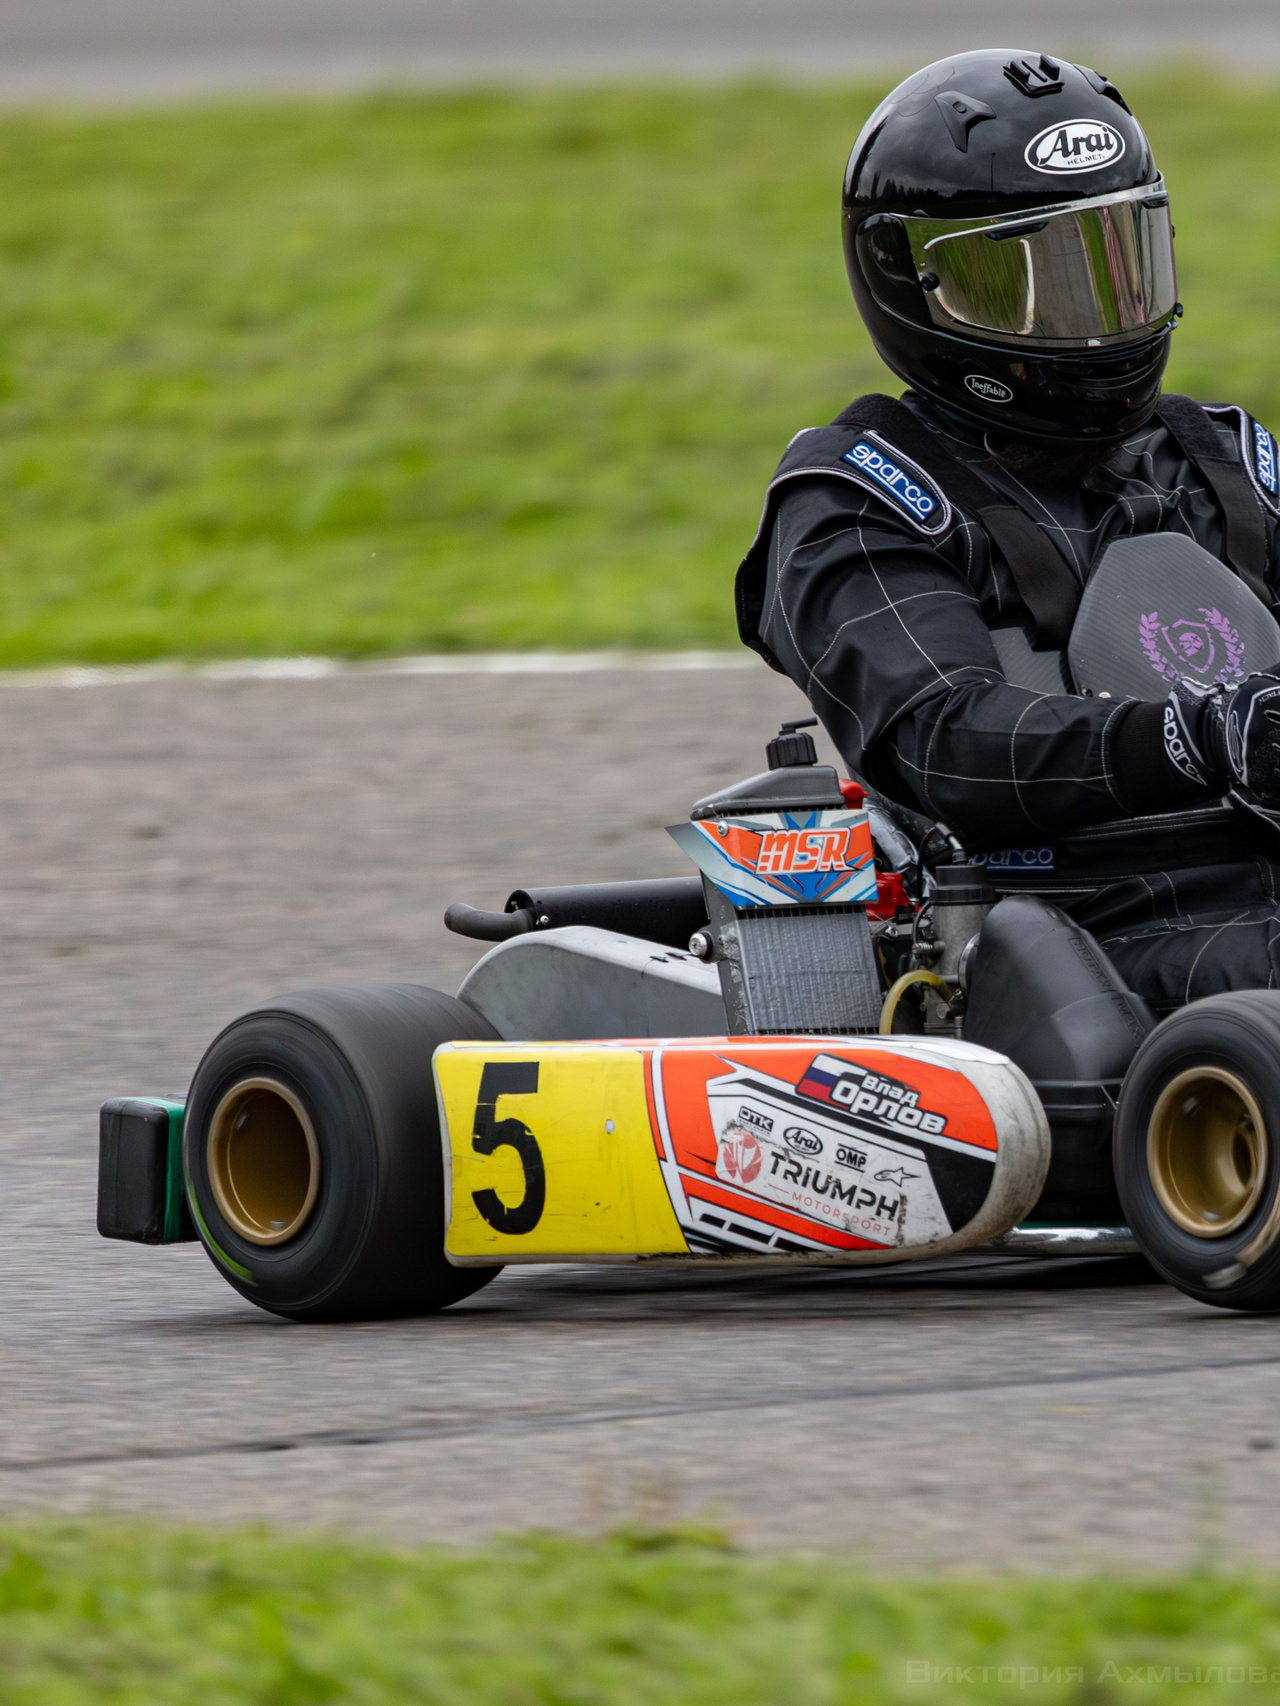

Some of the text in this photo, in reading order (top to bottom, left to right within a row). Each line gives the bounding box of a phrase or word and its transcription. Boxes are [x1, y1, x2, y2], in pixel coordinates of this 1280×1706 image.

[1037, 126, 1114, 166] Arai
[1067, 153, 1103, 166] HELMET
[971, 377, 1007, 398] Ineffable
[852, 445, 934, 512] sparco
[757, 829, 850, 873] MSR
[967, 848, 1054, 866] parco
[831, 1080, 947, 1134] Орлов
[861, 1074, 920, 1107] Влад
[739, 1106, 774, 1132] OTK
[472, 1061, 546, 1235] 5
[786, 1130, 818, 1151] Arai
[836, 1148, 867, 1168] OMP
[770, 1151, 900, 1222] TRIUMPH
[791, 1191, 892, 1236] MOTORSPORT
